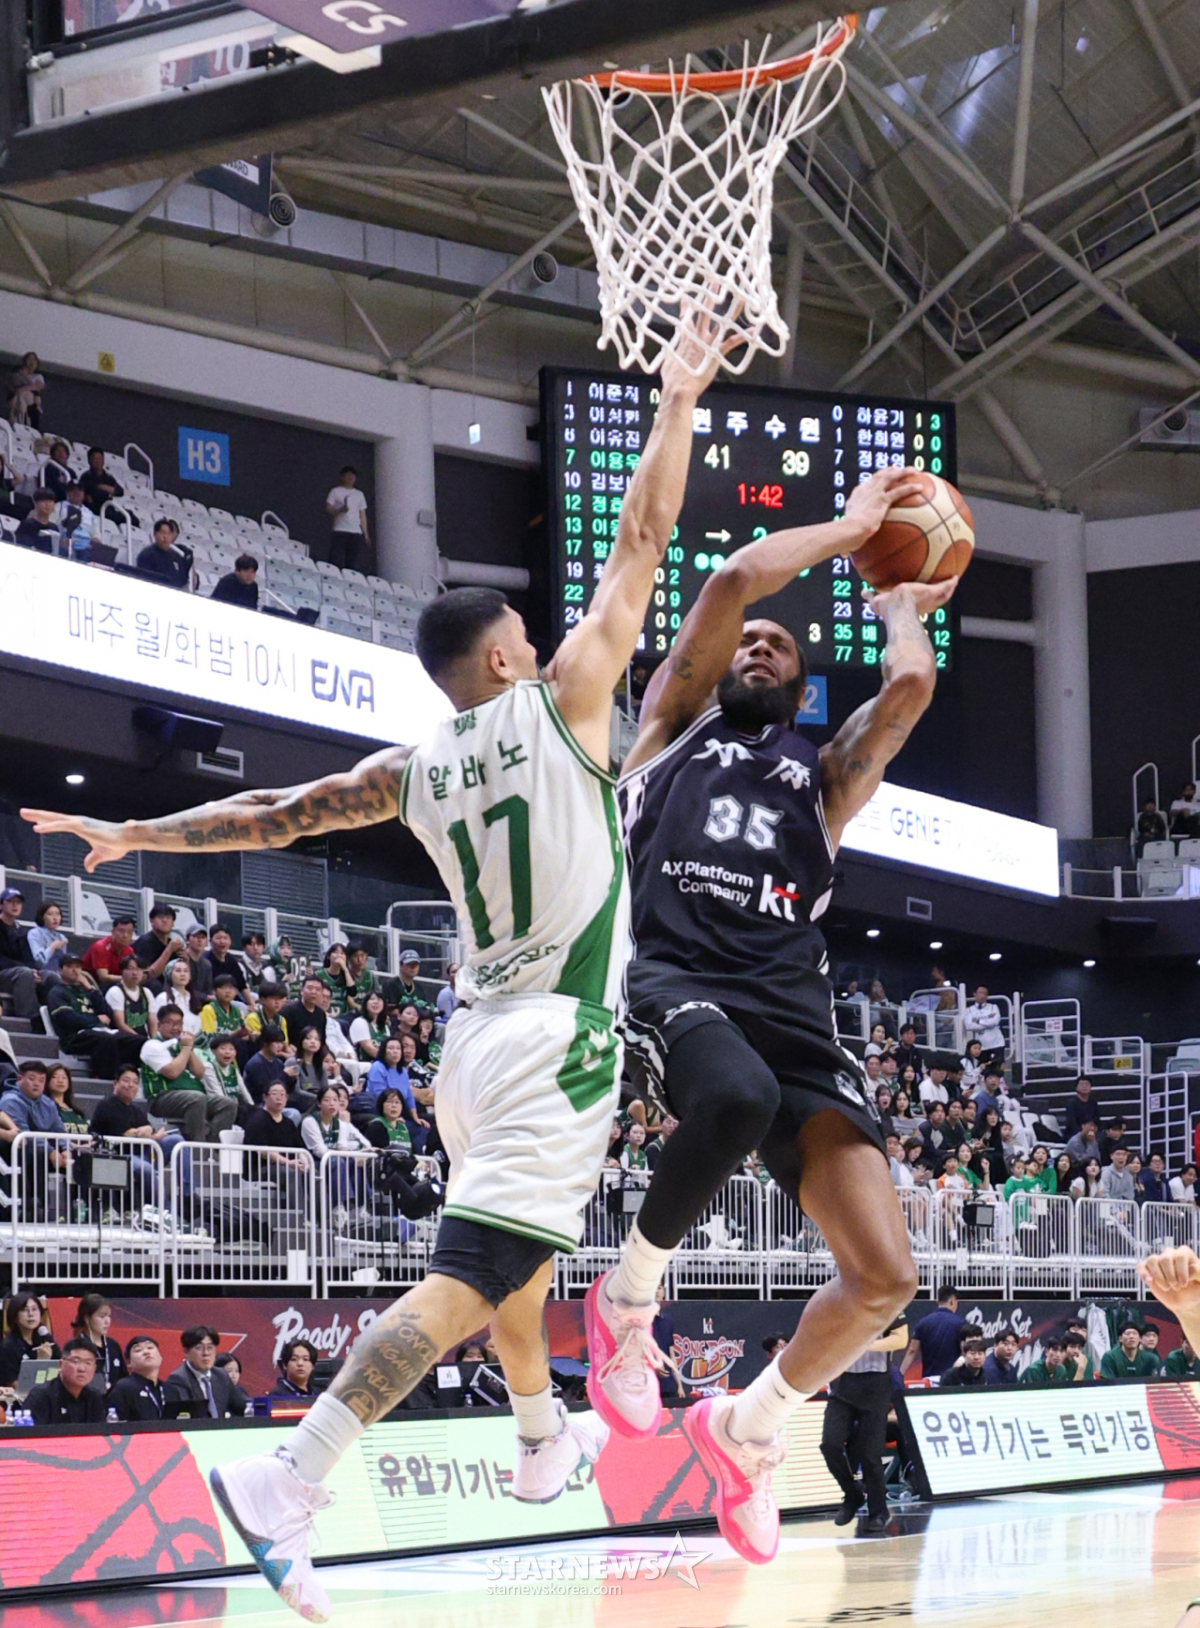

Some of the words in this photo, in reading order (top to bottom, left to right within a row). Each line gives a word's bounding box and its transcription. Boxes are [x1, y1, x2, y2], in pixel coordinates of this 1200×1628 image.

[832, 405, 843, 422] 0
[857, 406, 905, 428] 하윤기
[915, 412, 923, 429] 1
[930, 413, 941, 431] 3
[590, 427, 641, 448] 이유진
[835, 427, 843, 444] 1
[858, 428, 906, 449] 한희원
[913, 433, 925, 451] 0
[930, 435, 942, 453] 0
[187, 437, 222, 474] H3
[565, 448, 576, 467] 7
[590, 450, 641, 471] 이용우
[704, 443, 731, 470] 41
[782, 449, 811, 477] 39
[834, 448, 845, 466] 7
[914, 455, 925, 472] 0
[931, 456, 943, 475] 0
[564, 470, 582, 488] 10
[833, 470, 845, 488] 8
[564, 495, 582, 512] 12
[592, 495, 624, 514] 정효
[737, 482, 785, 509] 1:42
[834, 492, 846, 510] 9
[565, 516, 583, 534] 13
[565, 538, 583, 556] 17
[667, 545, 685, 564] 10
[566, 560, 584, 578] 19
[654, 567, 666, 584] 0
[669, 568, 680, 586] 2
[832, 558, 850, 575] 21
[564, 583, 584, 602] 22
[655, 589, 666, 607] 0
[669, 590, 681, 608] 9
[832, 580, 852, 598] 22
[565, 605, 584, 624] 24
[655, 612, 666, 629] 0
[670, 612, 681, 630] 0
[833, 601, 852, 619] 23
[935, 607, 946, 625] 0
[656, 633, 667, 651] 3
[808, 622, 821, 643] 3
[834, 623, 853, 641] 35
[934, 630, 951, 647] 12
[68, 594, 125, 649] 매주
[135, 611, 201, 669] 월/화
[208, 631, 235, 677] 밤
[243, 640, 297, 693] 10시
[310, 658, 376, 713] ENA
[834, 645, 853, 662] 77
[428, 740, 528, 800] 알바노
[703, 794, 786, 851] 35
[890, 806, 941, 846] GENIE
[446, 793, 533, 950] 17
[660, 860, 684, 877] AX
[684, 861, 755, 889] Platform
[678, 877, 753, 908] Company
[757, 873, 802, 923] kt
[702, 1317, 715, 1335] kt
[672, 1333, 708, 1370] SONIC
[922, 1410, 1053, 1461] 유압기기는
[378, 1453, 513, 1500] 유압기기는
